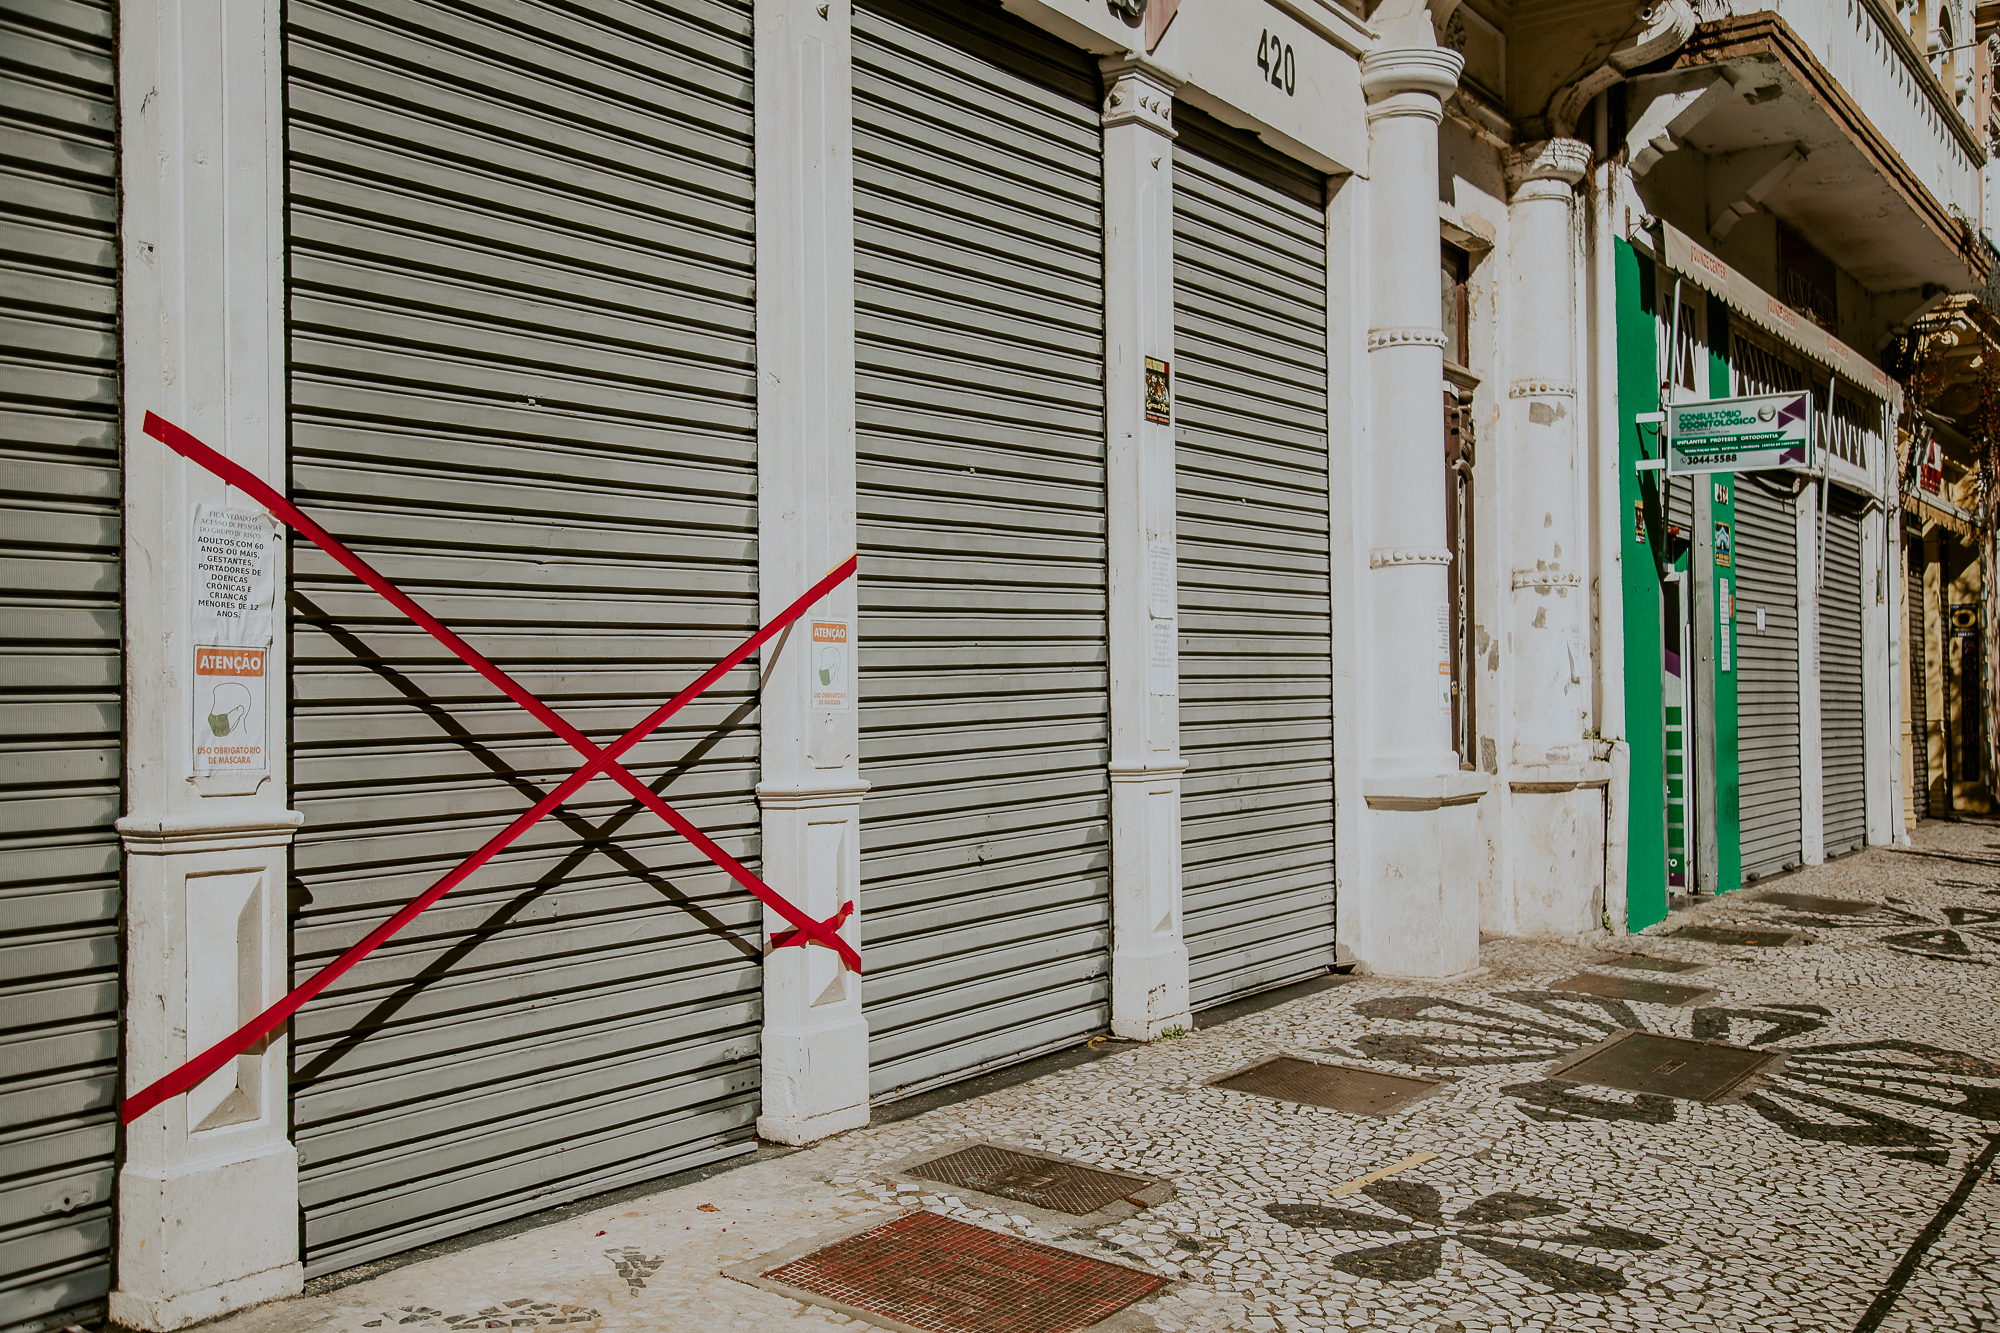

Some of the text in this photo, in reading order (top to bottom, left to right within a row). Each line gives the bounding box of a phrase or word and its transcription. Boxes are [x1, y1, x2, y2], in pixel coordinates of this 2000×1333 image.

[1257, 28, 1296, 97] 420
[1710, 258, 1726, 280] CENTER
[1679, 409, 1741, 422] CONSULTÓRIO
[1679, 416, 1756, 430] ODONTOLÓGICO
[1741, 433, 1779, 441] ORTODONTIA
[1687, 453, 1737, 465] 3044-5588
[227, 513, 251, 522] VEDADO
[201, 518, 228, 527] ACESSO
[237, 523, 262, 531] PESSOAS
[211, 527, 234, 536] GRUPO
[198, 536, 234, 546] ADULTOS
[236, 540, 253, 549] COM
[201, 545, 224, 554] ANOS
[240, 550, 260, 559] MAIS,
[207, 555, 254, 567] GESTANTES,
[198, 563, 250, 575] PORTADORES
[211, 574, 248, 584] DOENÇAS
[209, 592, 248, 602] CRIANÇAS
[198, 600, 236, 609] MENORES
[216, 610, 241, 618] ANOS.
[814, 626, 846, 641] ATENÇÃO
[199, 653, 261, 673] ATENÇÃO
[197, 745, 261, 755] USO OBRIGATÓRIO
[218, 755, 251, 765] MÁSCARA
[952, 1254, 1030, 1284] RECALQUE
[957, 1275, 980, 1286] DE
[906, 1277, 983, 1306] HIDRANTE
